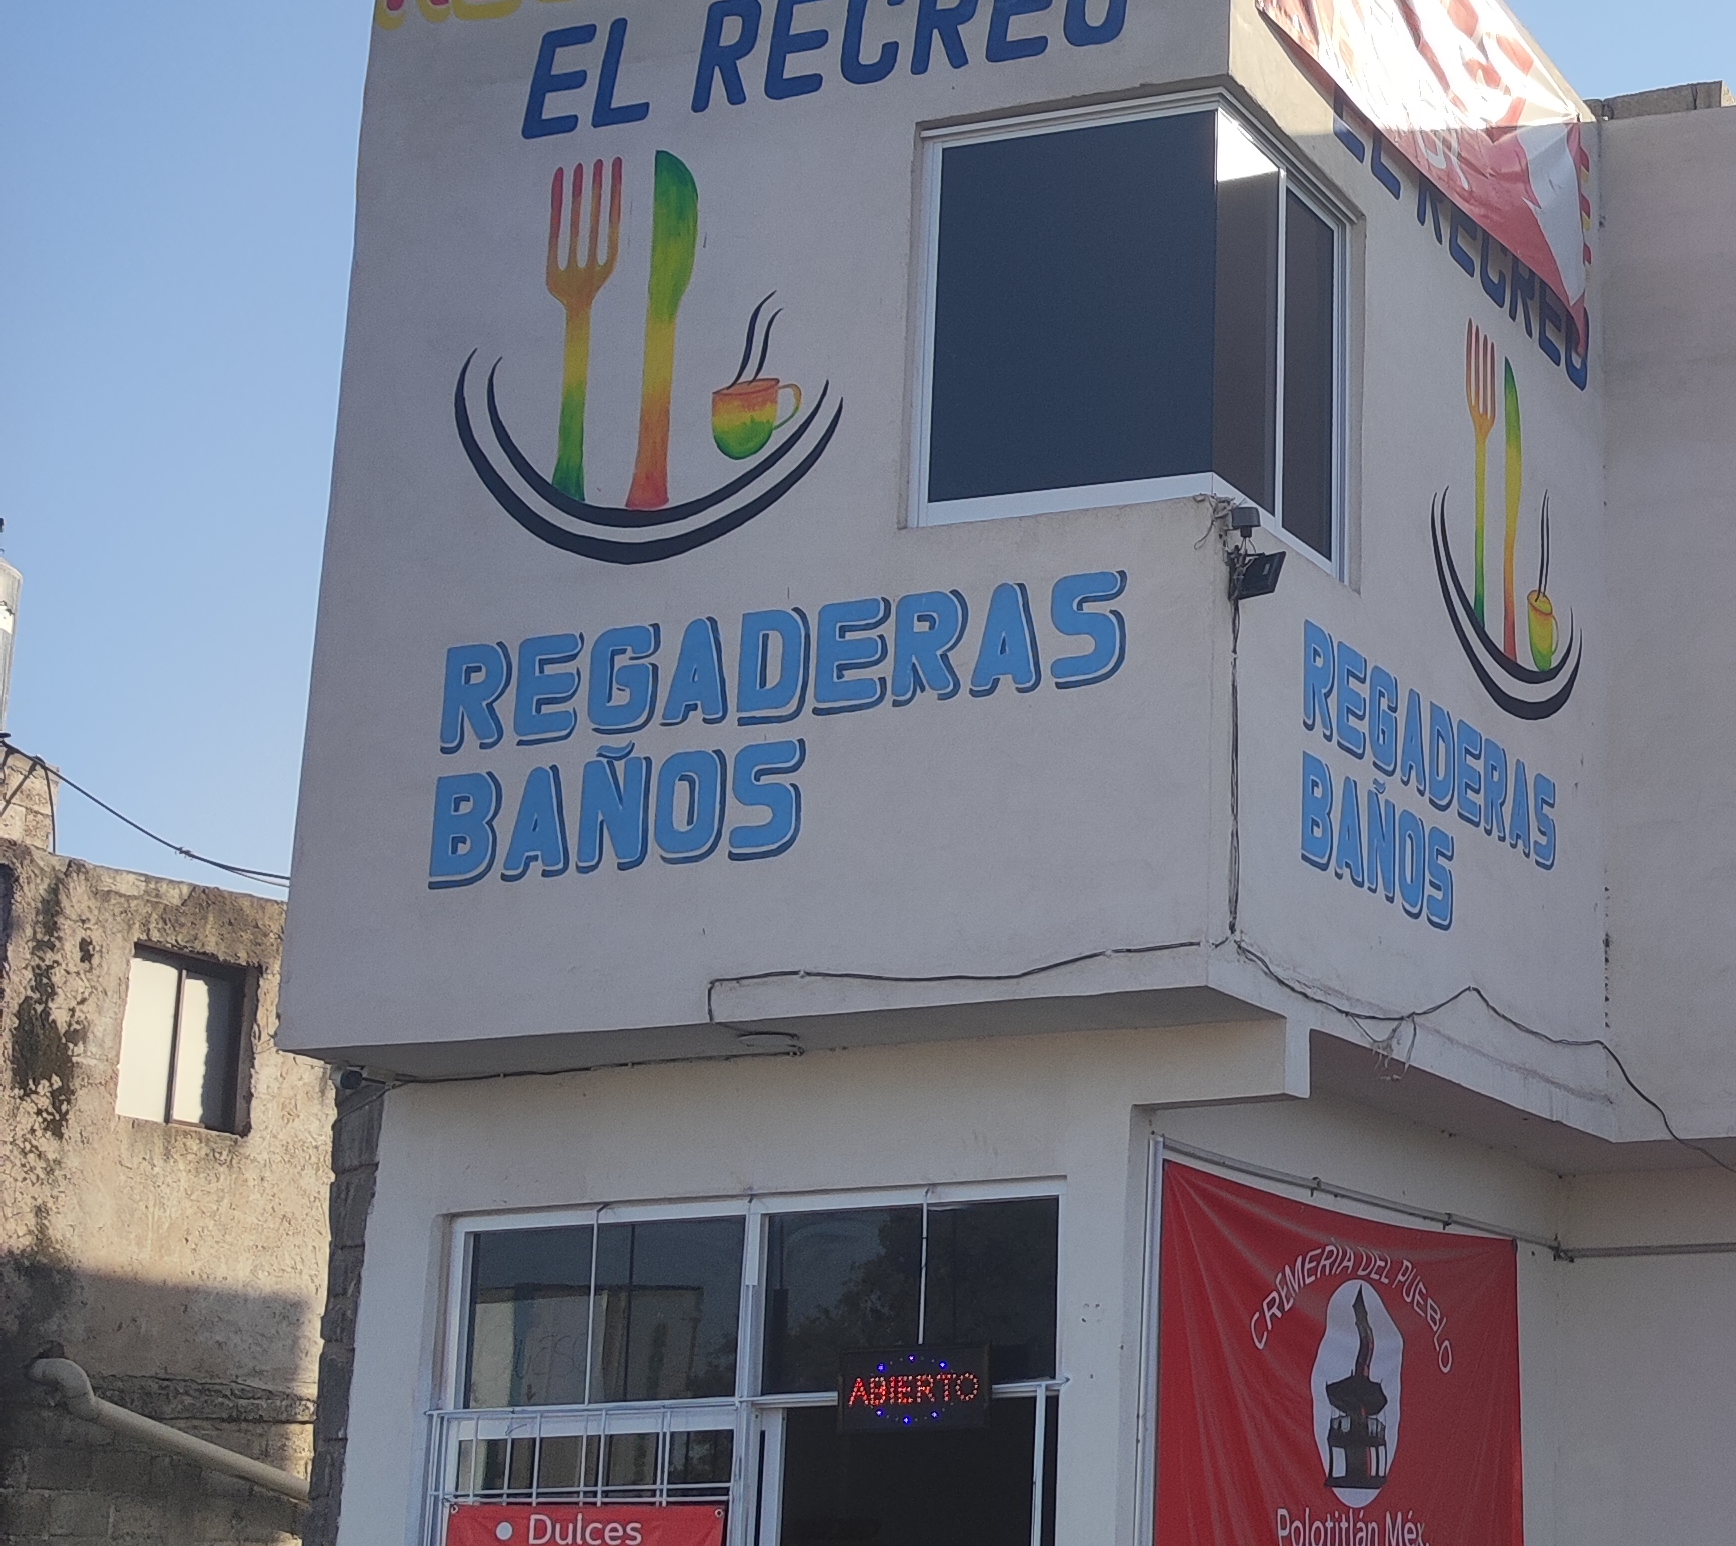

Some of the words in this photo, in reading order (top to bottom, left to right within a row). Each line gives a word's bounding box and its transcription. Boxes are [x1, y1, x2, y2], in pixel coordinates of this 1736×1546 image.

[521, 18, 650, 139] EL
[439, 570, 1127, 753] REGADERAS
[1303, 618, 1557, 871] REGADERAS
[428, 739, 806, 889] BAÑOS
[1301, 750, 1454, 931] BAÑOS
[1357, 1246, 1391, 1284] DEL
[1392, 1259, 1453, 1373] PUEBLO
[848, 1371, 979, 1407] ABIERTO
[528, 1513, 642, 1546] Dulces
